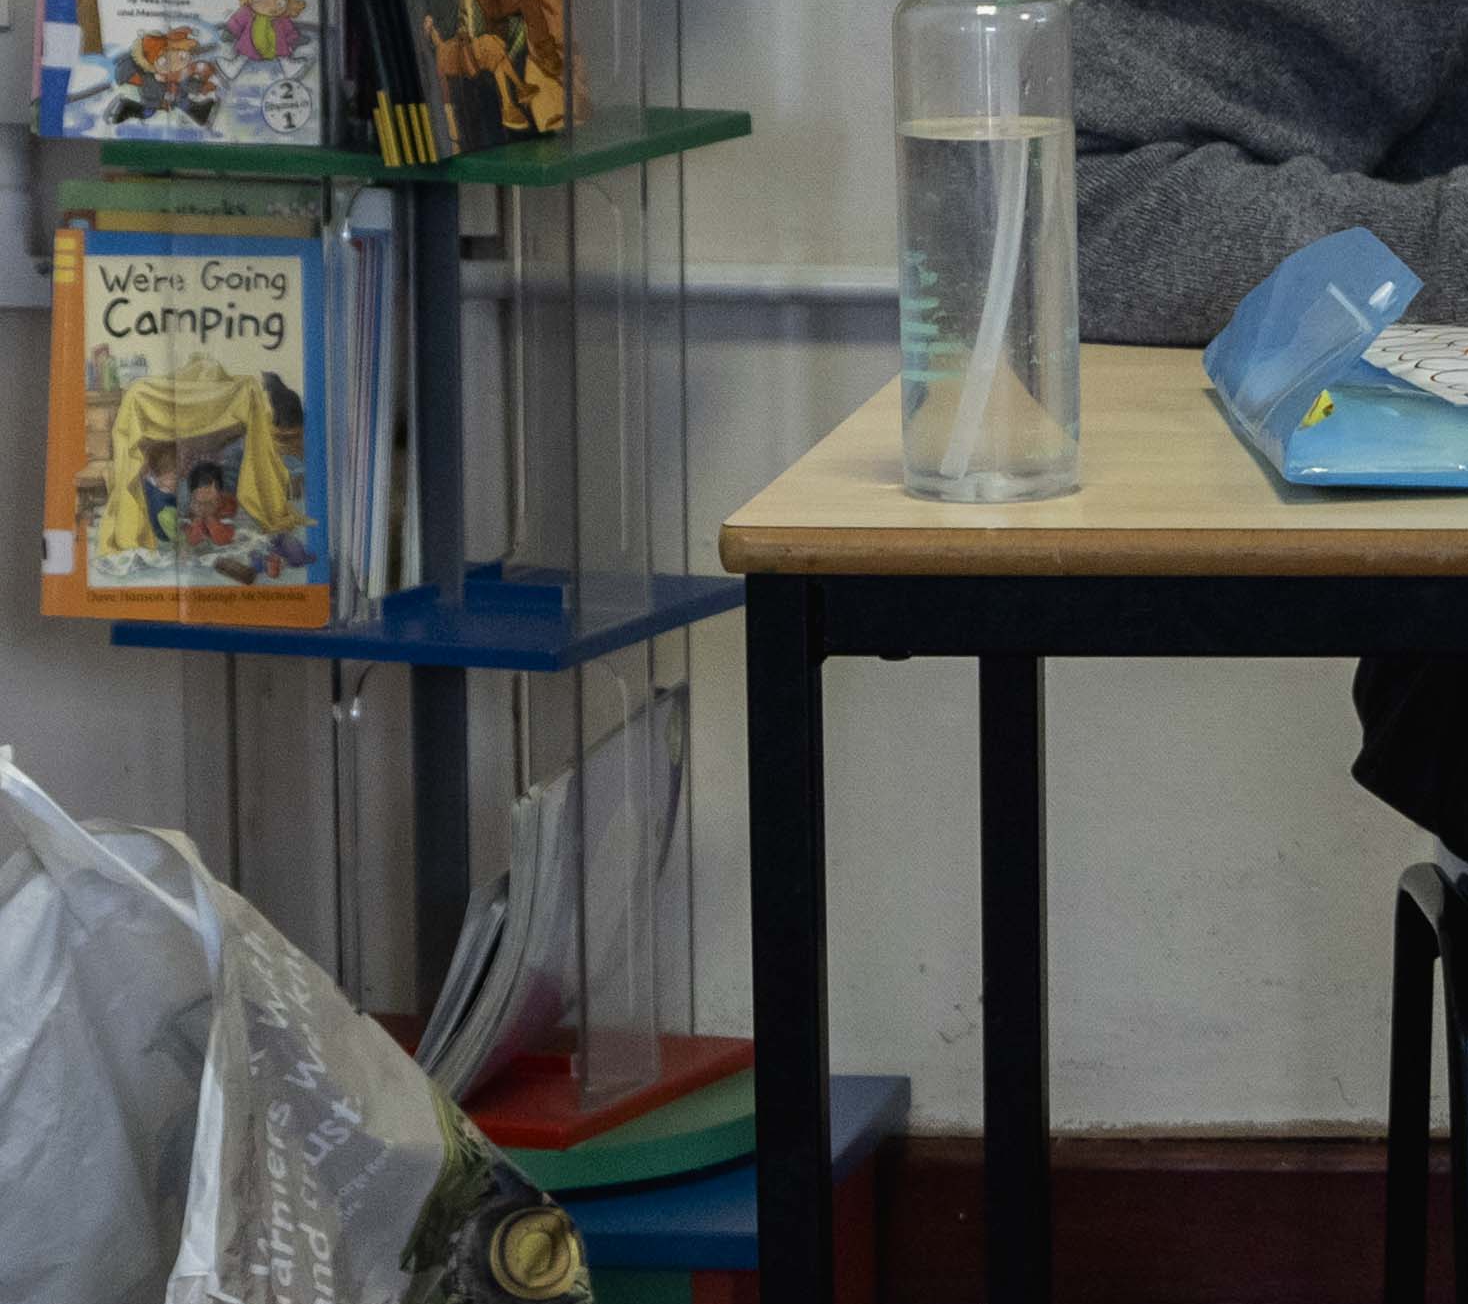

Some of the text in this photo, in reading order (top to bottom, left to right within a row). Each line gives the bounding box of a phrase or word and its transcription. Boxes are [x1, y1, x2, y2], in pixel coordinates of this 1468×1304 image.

[280, 81, 294, 100] 2
[283, 112, 296, 130] 1
[98, 260, 288, 299] We're Going
[102, 297, 287, 351] Camping
